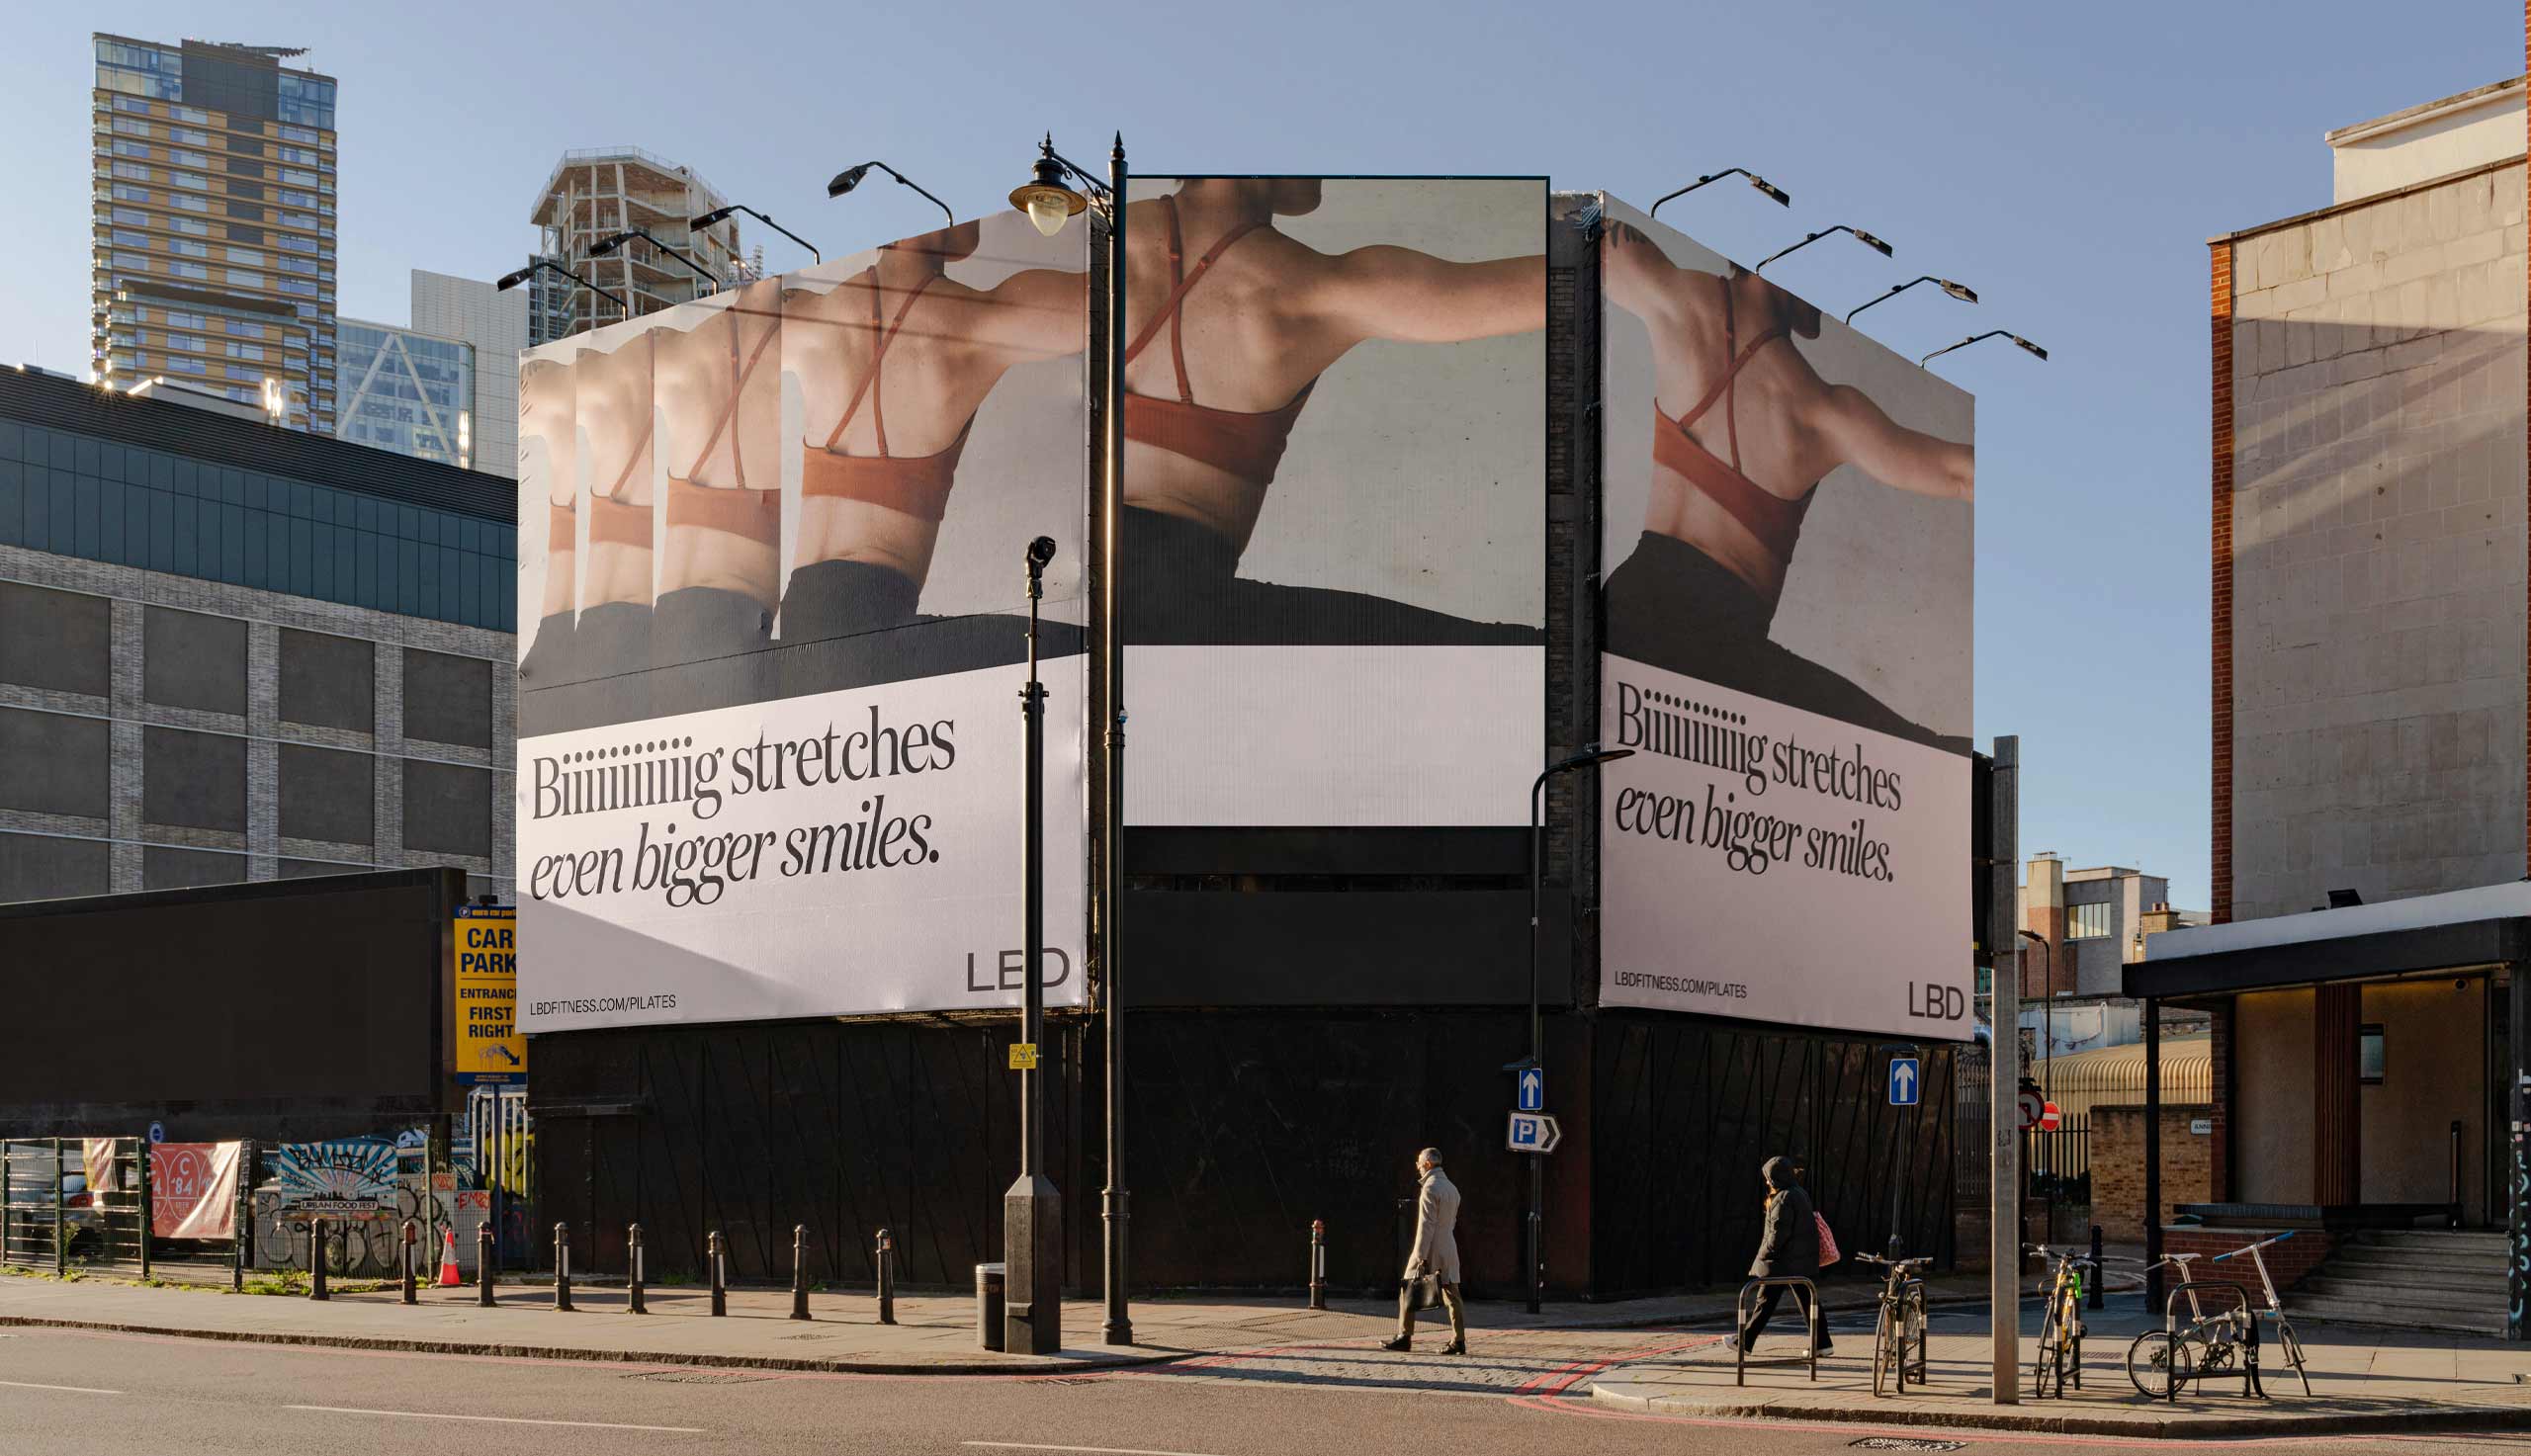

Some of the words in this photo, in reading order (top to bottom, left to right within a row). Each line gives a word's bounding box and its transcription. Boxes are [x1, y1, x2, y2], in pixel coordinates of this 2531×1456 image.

[731, 705, 956, 796] stretches
[1772, 732, 1901, 812] stretches
[1615, 787, 1696, 844] even
[1701, 784, 1802, 876] bigger
[1803, 818, 1894, 883] smiles.
[530, 847, 624, 901] even
[631, 821, 777, 908] bigger
[779, 794, 940, 878] smiles.
[468, 927, 513, 949] CAR
[461, 953, 516, 974] PARK
[460, 988, 516, 999] ENTRANC
[1615, 970, 1748, 999] LBDFITNESS.COM/PILATES
[529, 994, 676, 1016] LBDFITNESS.COM/PILATES
[1908, 981, 1964, 1021] LBD
[470, 1006, 512, 1020] FIRST
[469, 1024, 514, 1038] RIGHT
[1518, 1120, 1534, 1142] P
